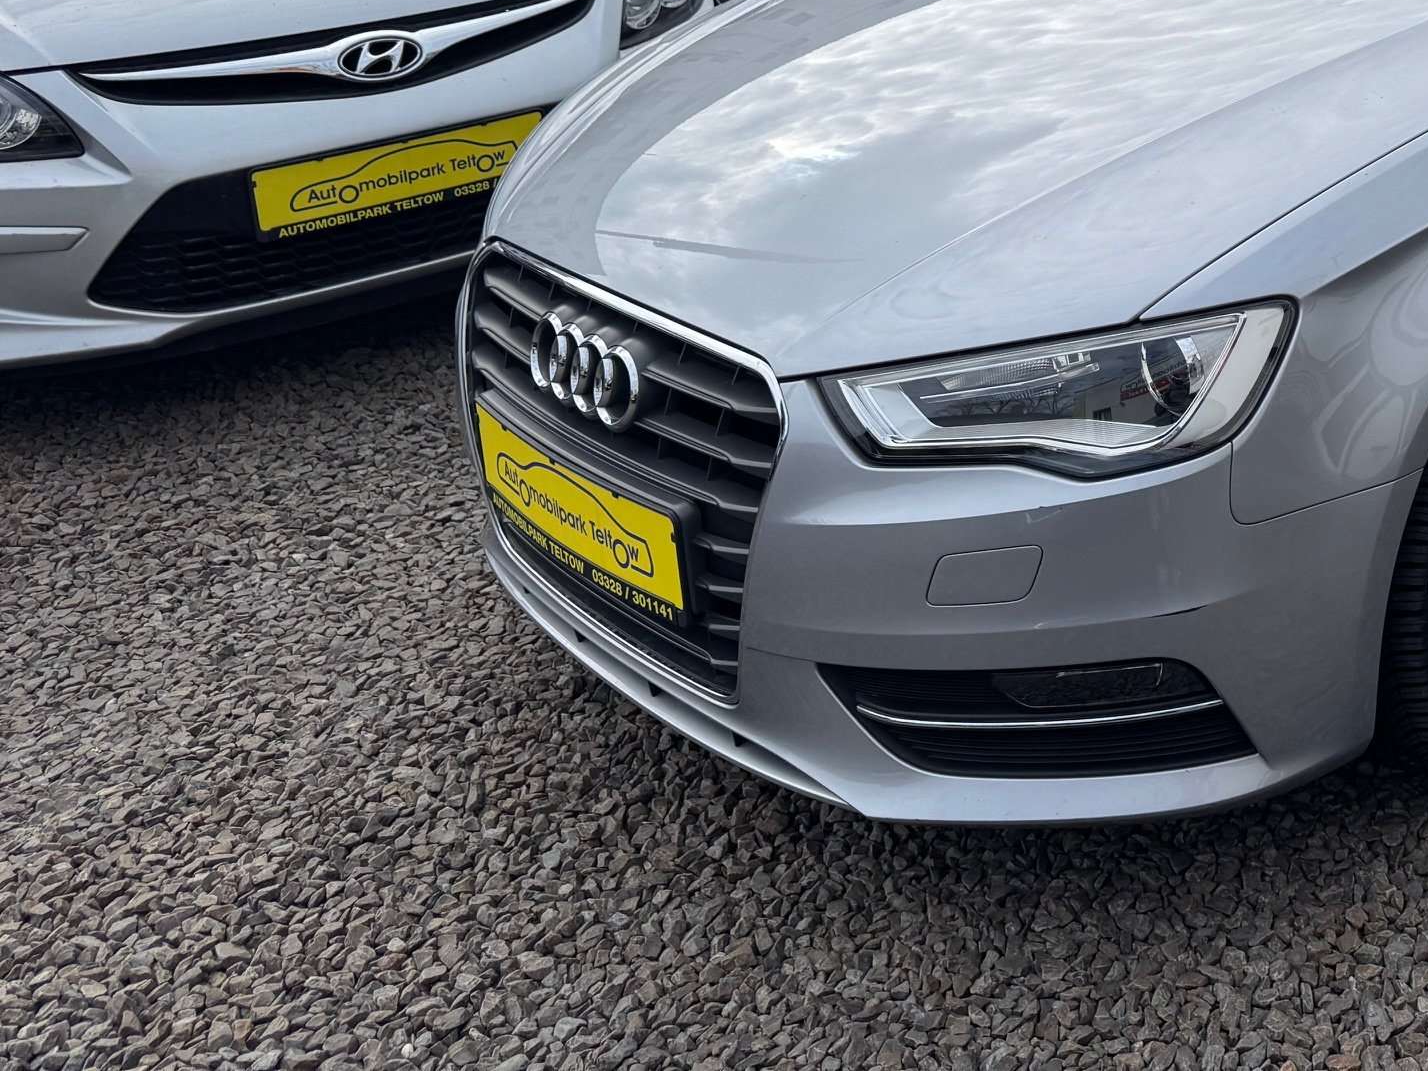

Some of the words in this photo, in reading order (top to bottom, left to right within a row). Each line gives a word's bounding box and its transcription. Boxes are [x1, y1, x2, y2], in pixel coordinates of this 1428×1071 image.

[278, 203, 392, 239] AUTOMOBILPARK
[394, 191, 445, 212] TELTOW
[454, 181, 490, 197] 03328
[492, 492, 549, 550] AUTOMOBILPARK
[549, 541, 584, 575] TELTOW
[592, 568, 623, 597] 03328
[632, 590, 673, 621] 301141
